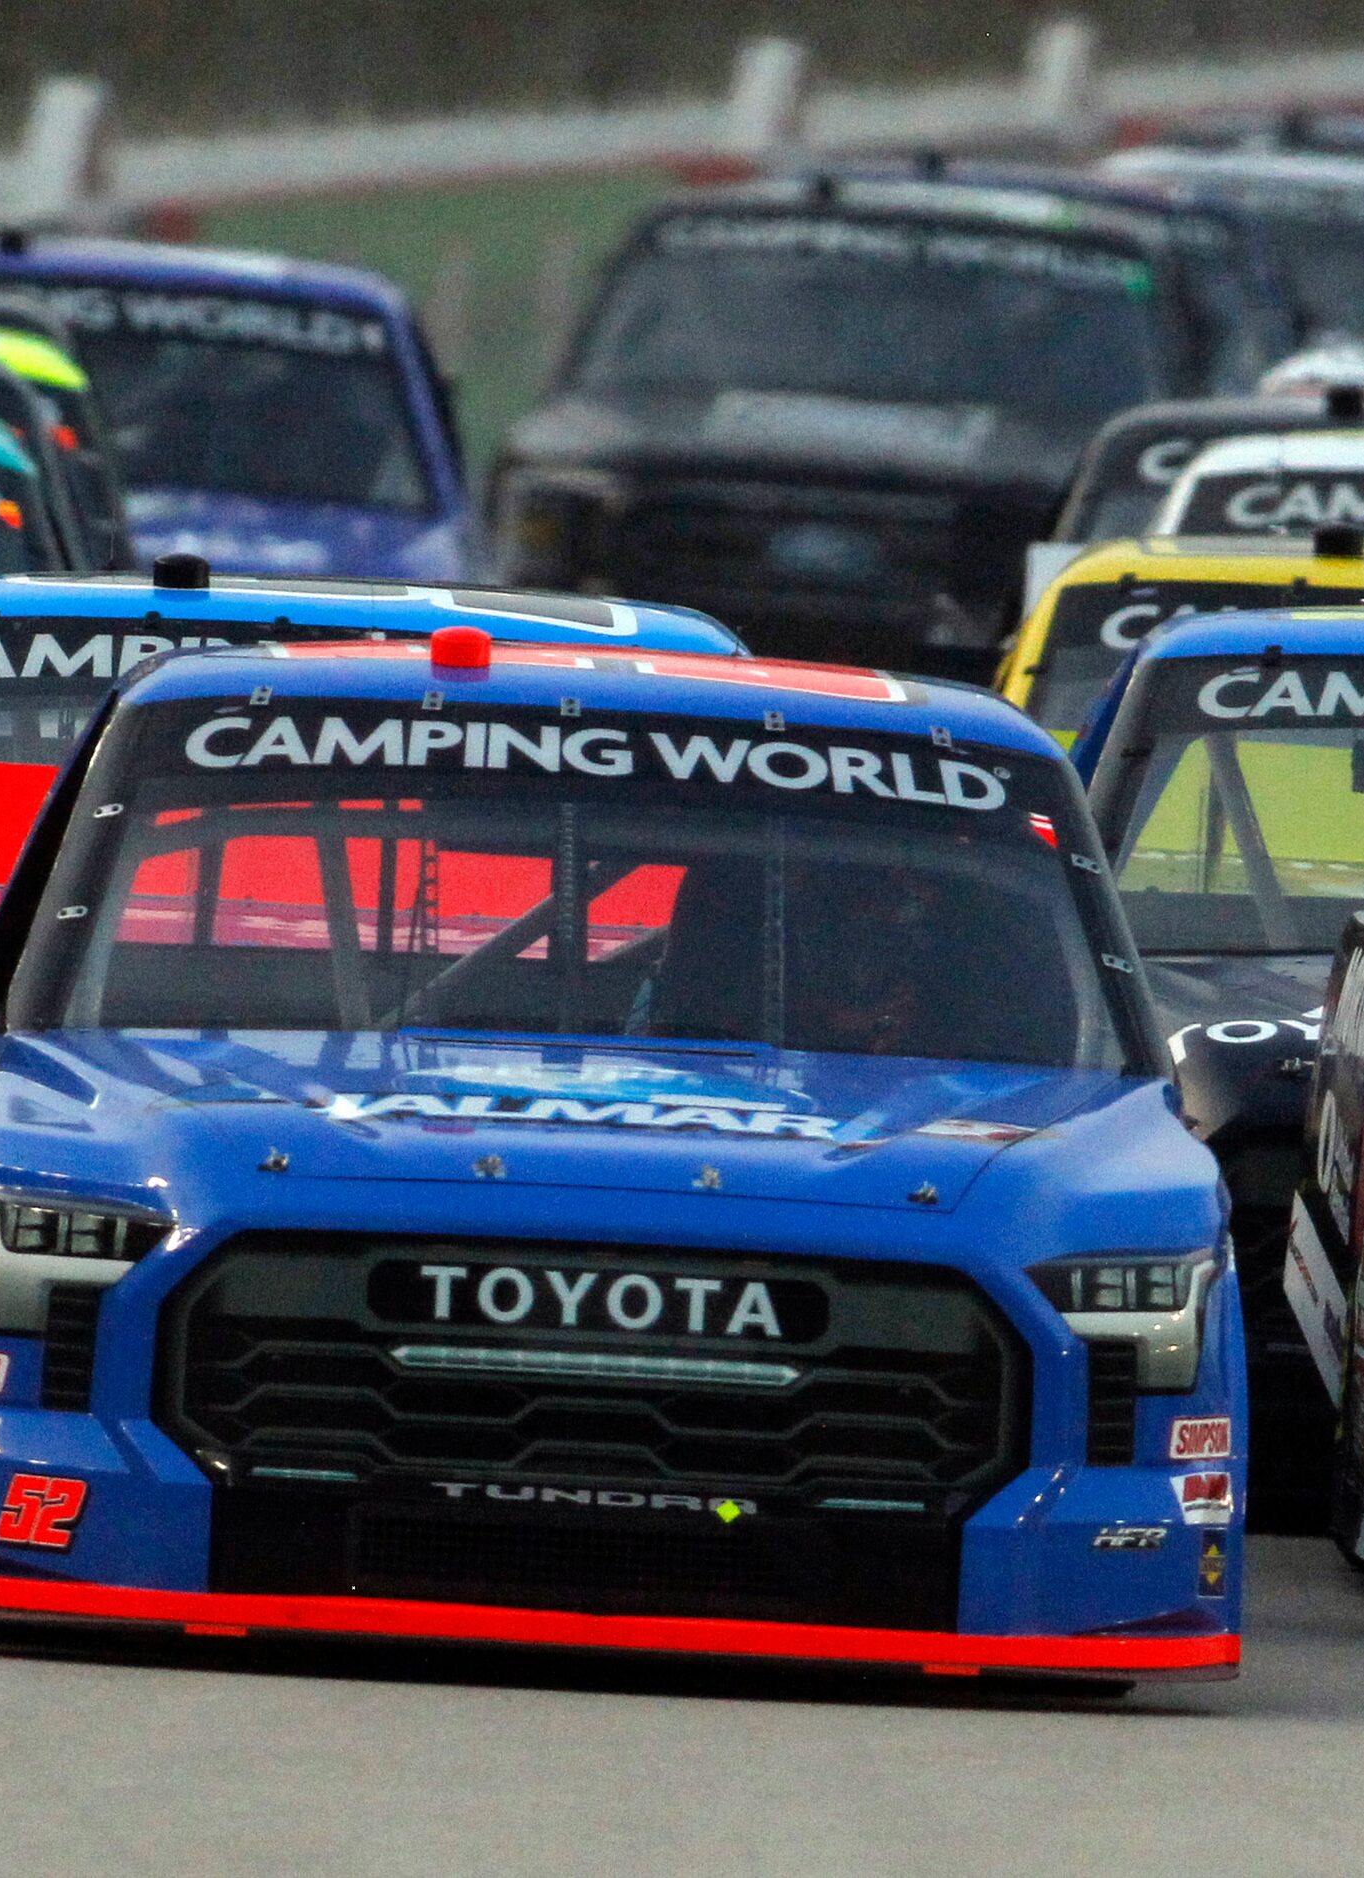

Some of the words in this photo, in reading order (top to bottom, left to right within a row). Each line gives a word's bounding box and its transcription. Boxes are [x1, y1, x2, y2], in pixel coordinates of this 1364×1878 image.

[185, 715, 634, 777] CAMPING
[648, 732, 1007, 811] WORLD
[419, 1263, 783, 1338] TOYOTA
[1176, 1420, 1230, 1456] SIMPSON
[430, 1481, 758, 1517] TUNDRA
